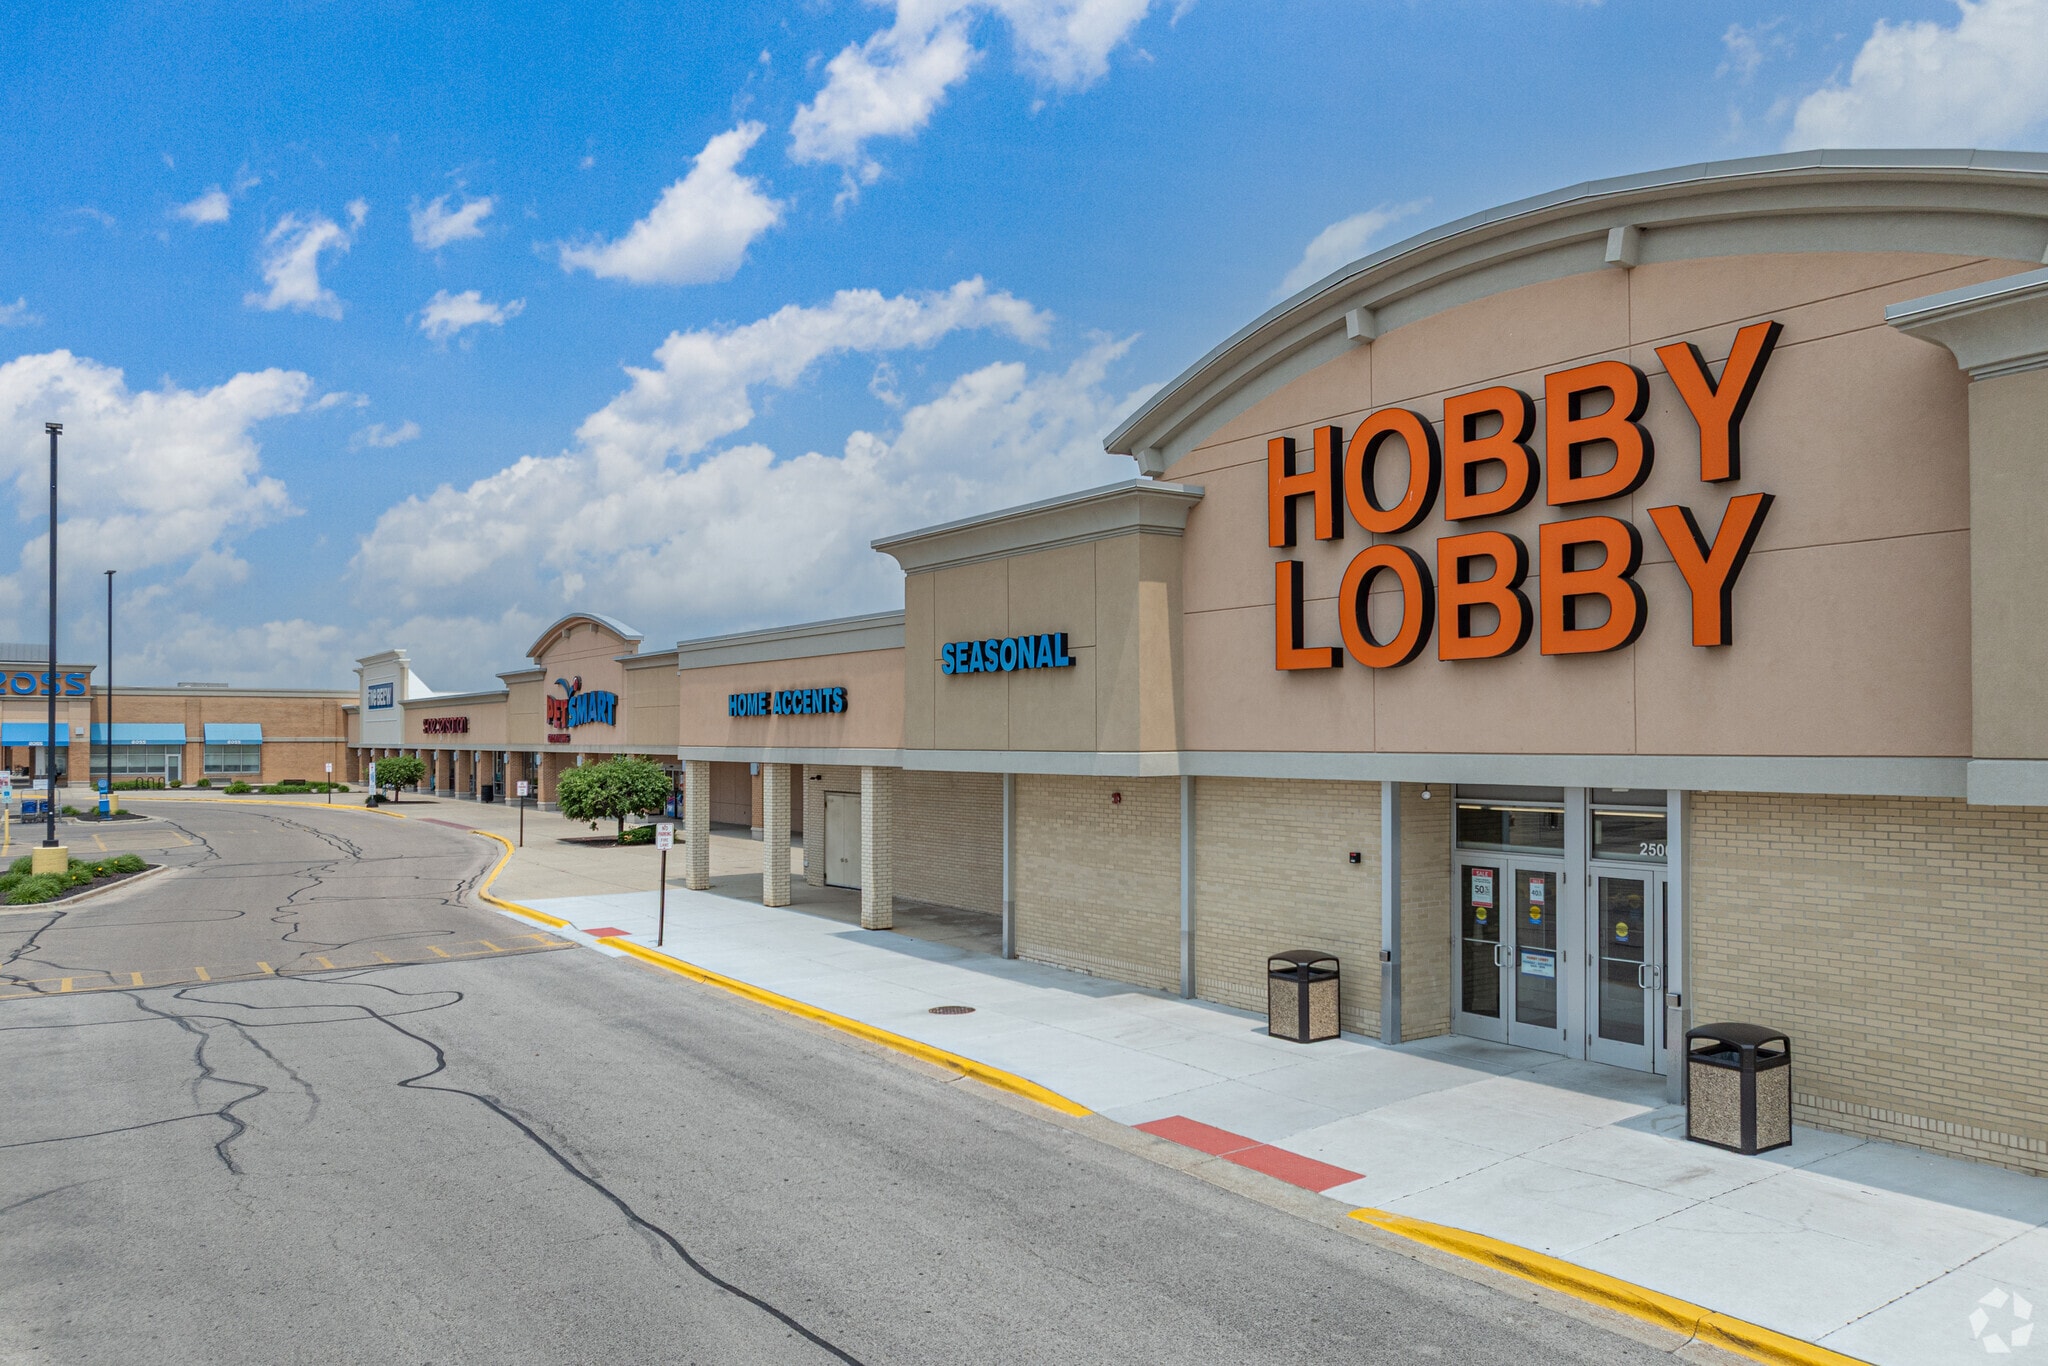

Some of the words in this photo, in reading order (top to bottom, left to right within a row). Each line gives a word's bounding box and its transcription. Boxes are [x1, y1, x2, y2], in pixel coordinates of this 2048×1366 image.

[1267, 320, 1783, 547] HOBBY
[1275, 492, 1776, 670] LOBBY
[728, 692, 771, 717] HOME
[772, 687, 848, 715] ACCENTS
[941, 632, 1076, 675] SEASONAL
